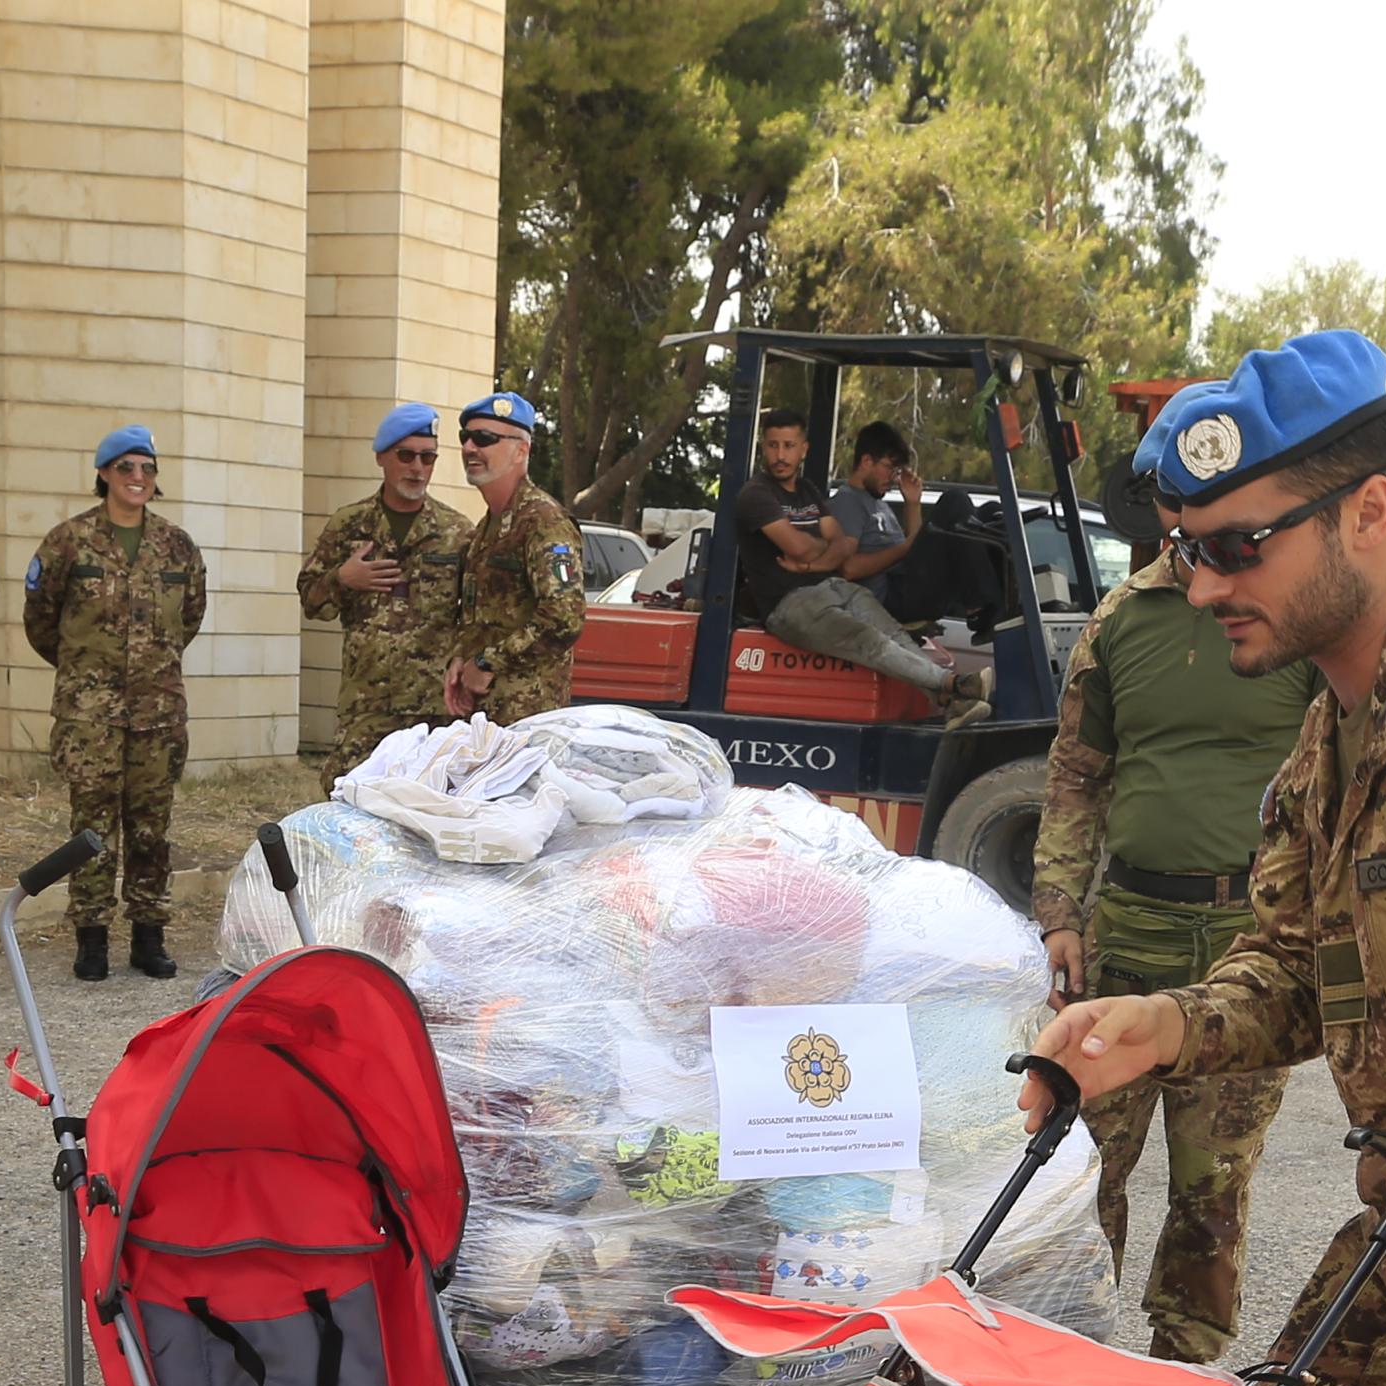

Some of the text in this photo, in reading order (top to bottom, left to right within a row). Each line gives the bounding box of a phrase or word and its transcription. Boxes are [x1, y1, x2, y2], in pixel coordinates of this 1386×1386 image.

[735, 647, 855, 672] 40 TOYOTA
[748, 1112, 894, 1126] ASSOCIAZIONE INTERNAZIONALE REGINA ELENA
